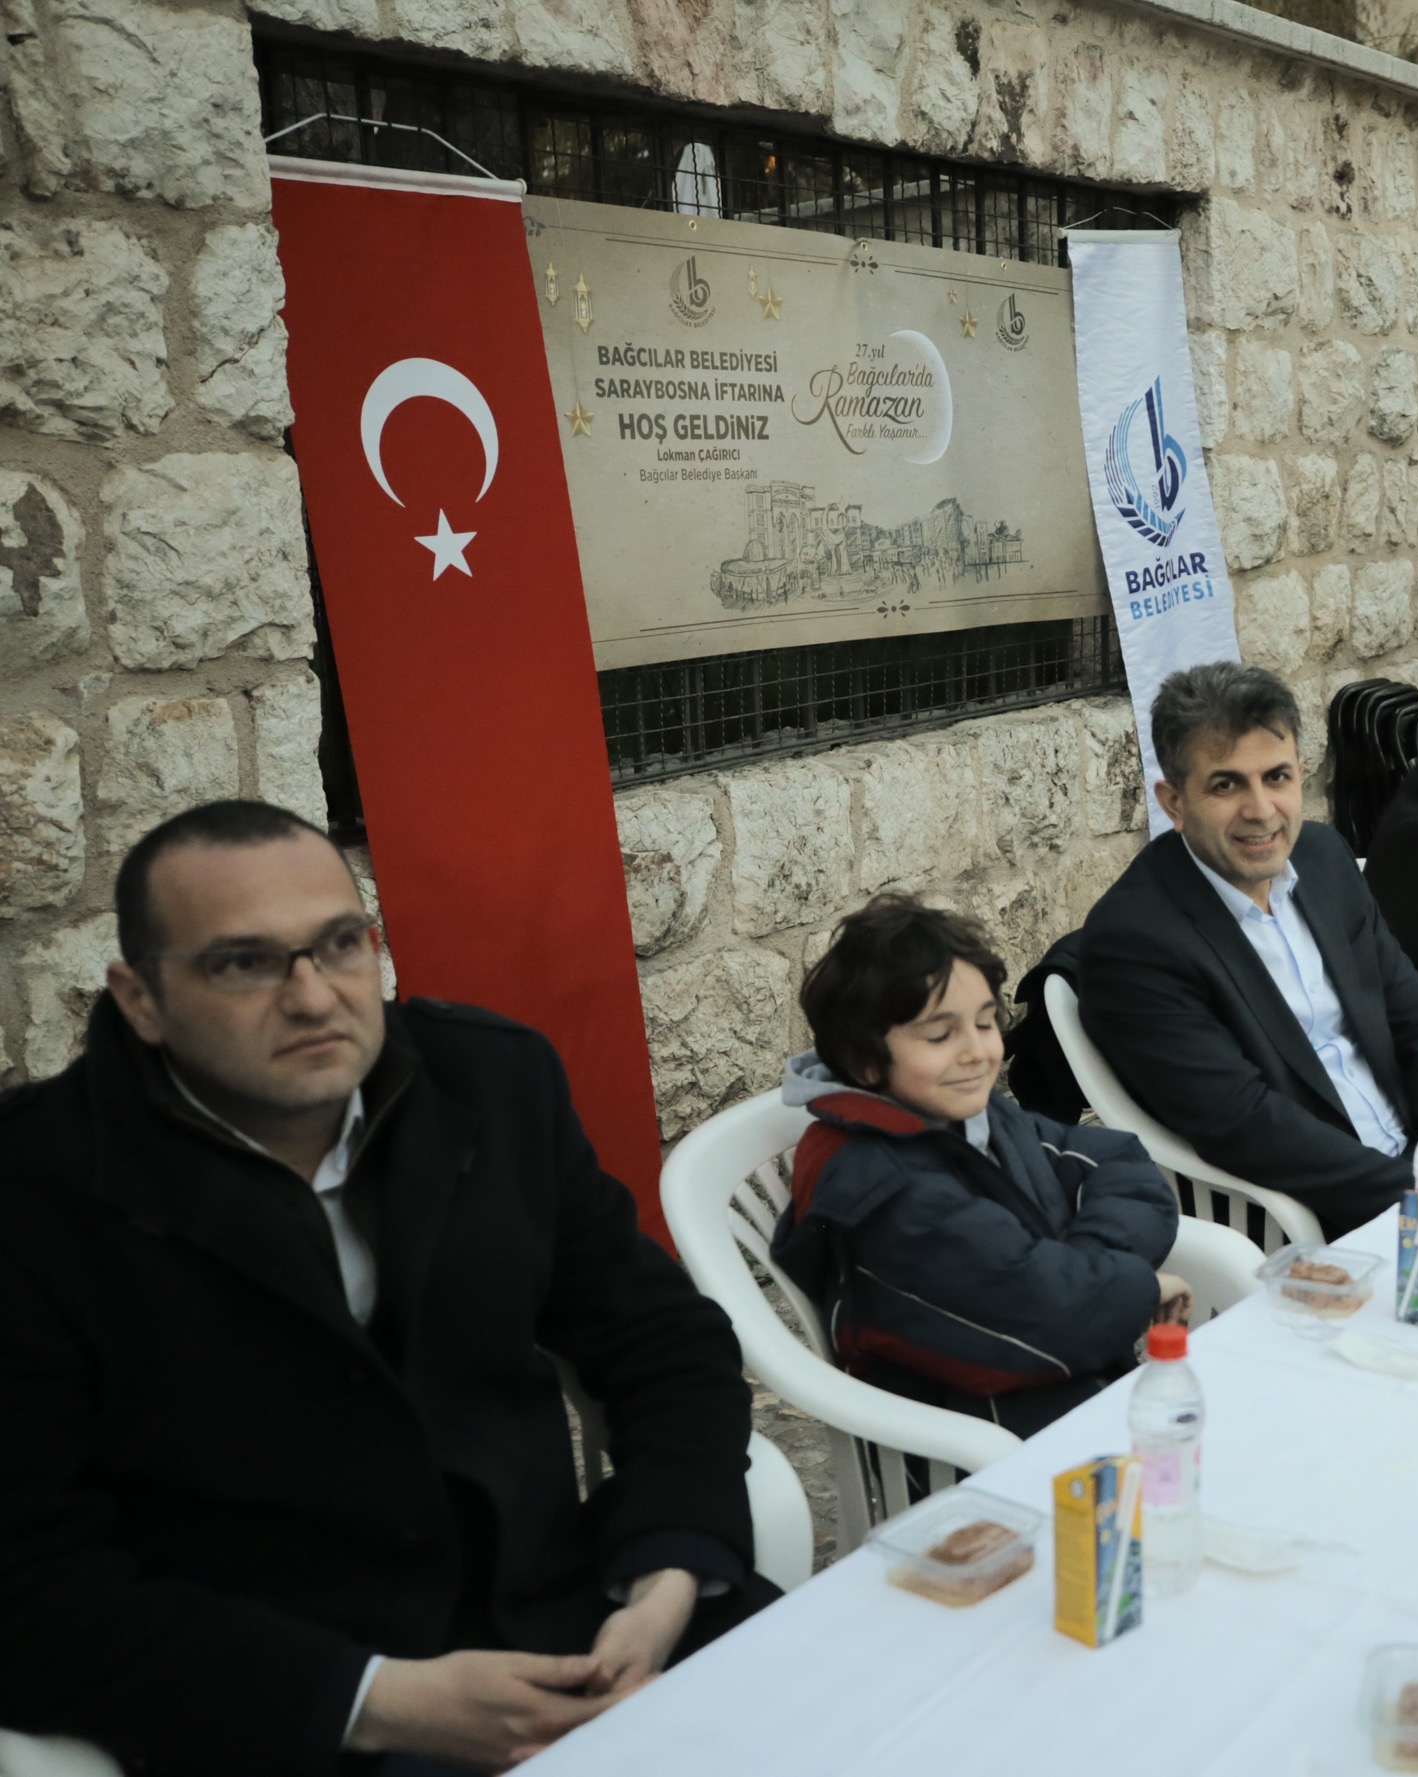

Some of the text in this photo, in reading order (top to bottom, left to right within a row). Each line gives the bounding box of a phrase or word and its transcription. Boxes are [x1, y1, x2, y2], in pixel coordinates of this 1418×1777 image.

[597, 342, 778, 373] BAĞCILAR BELEDİYESİ
[594, 378, 785, 402] SARAYBOSNA İFTARINA
[791, 364, 925, 456] Ramazan
[618, 413, 668, 445] HOŞ
[657, 446, 741, 463] Lokman ÇAĞIRICI
[639, 467, 758, 484] Bağcılar Belediye Başkanı
